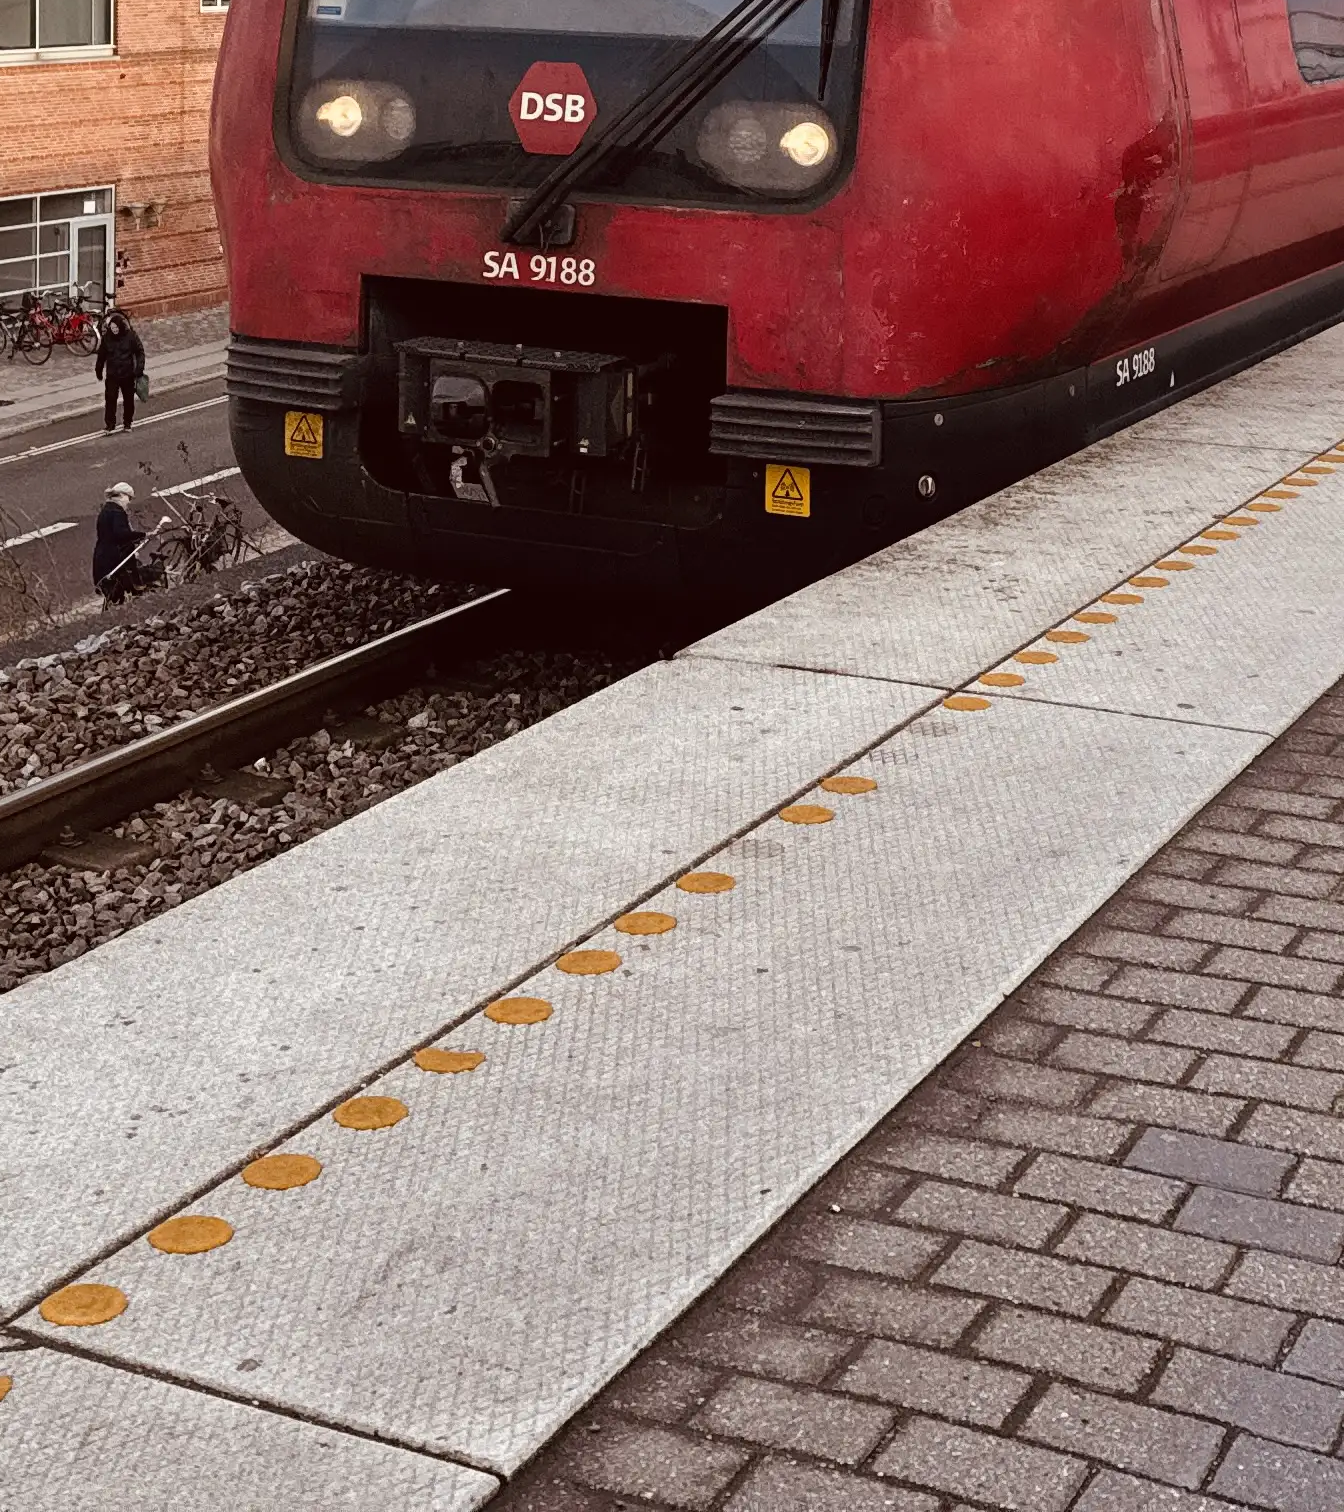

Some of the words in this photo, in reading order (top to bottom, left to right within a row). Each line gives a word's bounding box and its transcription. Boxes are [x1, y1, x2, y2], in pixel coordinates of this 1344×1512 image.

[519, 91, 586, 123] DSB
[482, 250, 520, 280] SA
[529, 254, 596, 286] 9188
[1116, 357, 1130, 387] SA
[1132, 347, 1156, 380] 9188
